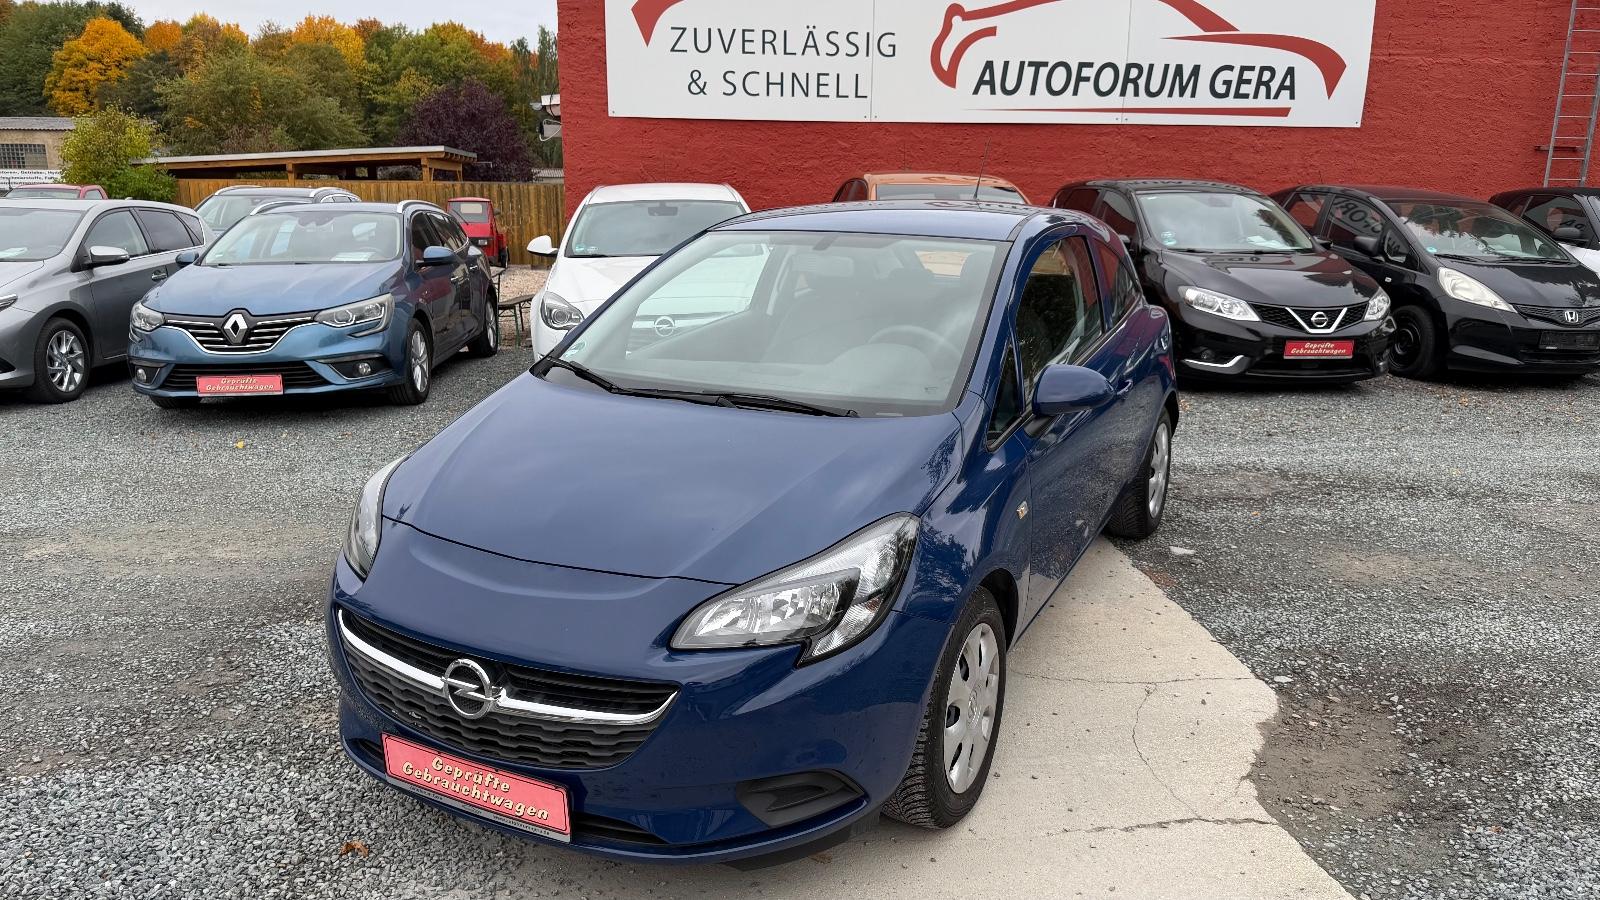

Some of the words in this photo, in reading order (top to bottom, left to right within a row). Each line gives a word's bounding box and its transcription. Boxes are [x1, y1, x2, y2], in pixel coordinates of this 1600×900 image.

[670, 25, 897, 58] ZUVERLÄSSIG
[687, 69, 708, 96] &
[722, 70, 868, 99] SCHNELL
[972, 60, 1200, 99] AUTOFORUM
[1209, 65, 1296, 100] GERA
[402, 761, 549, 820] Gebrauchtwagen
[432, 756, 511, 793] Geprüfte
